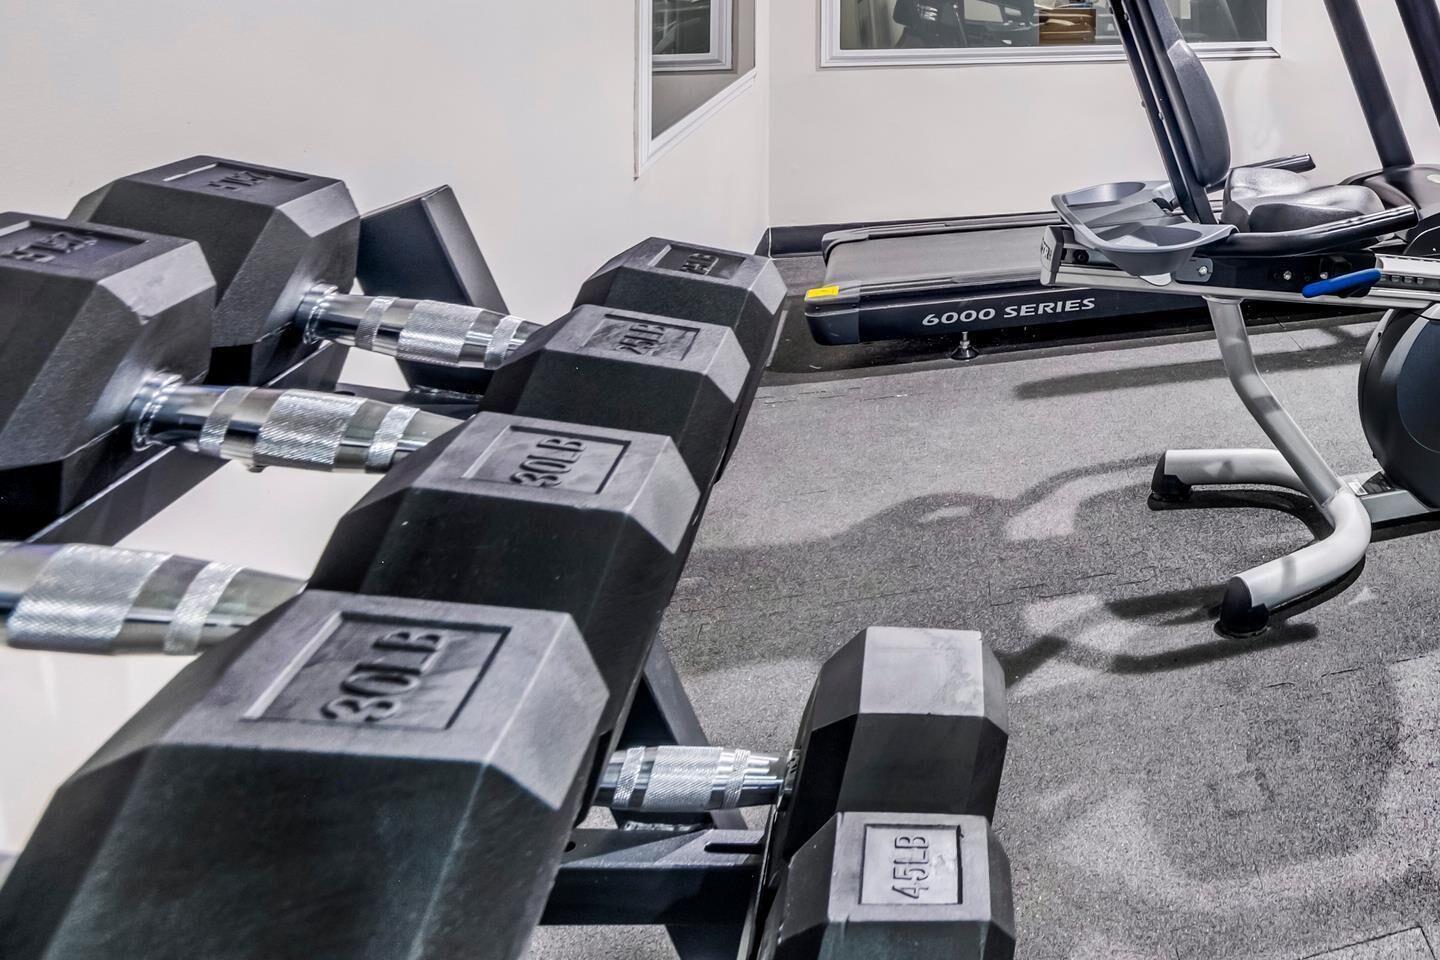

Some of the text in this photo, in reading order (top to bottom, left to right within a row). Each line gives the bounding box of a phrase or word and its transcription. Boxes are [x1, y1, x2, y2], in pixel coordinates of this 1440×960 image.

[922, 298, 1096, 326] 6000 SERIES
[615, 322, 669, 356] 25LB
[509, 437, 586, 488] 30LB
[320, 630, 446, 723] 30LB
[892, 836, 929, 899] 45LB
